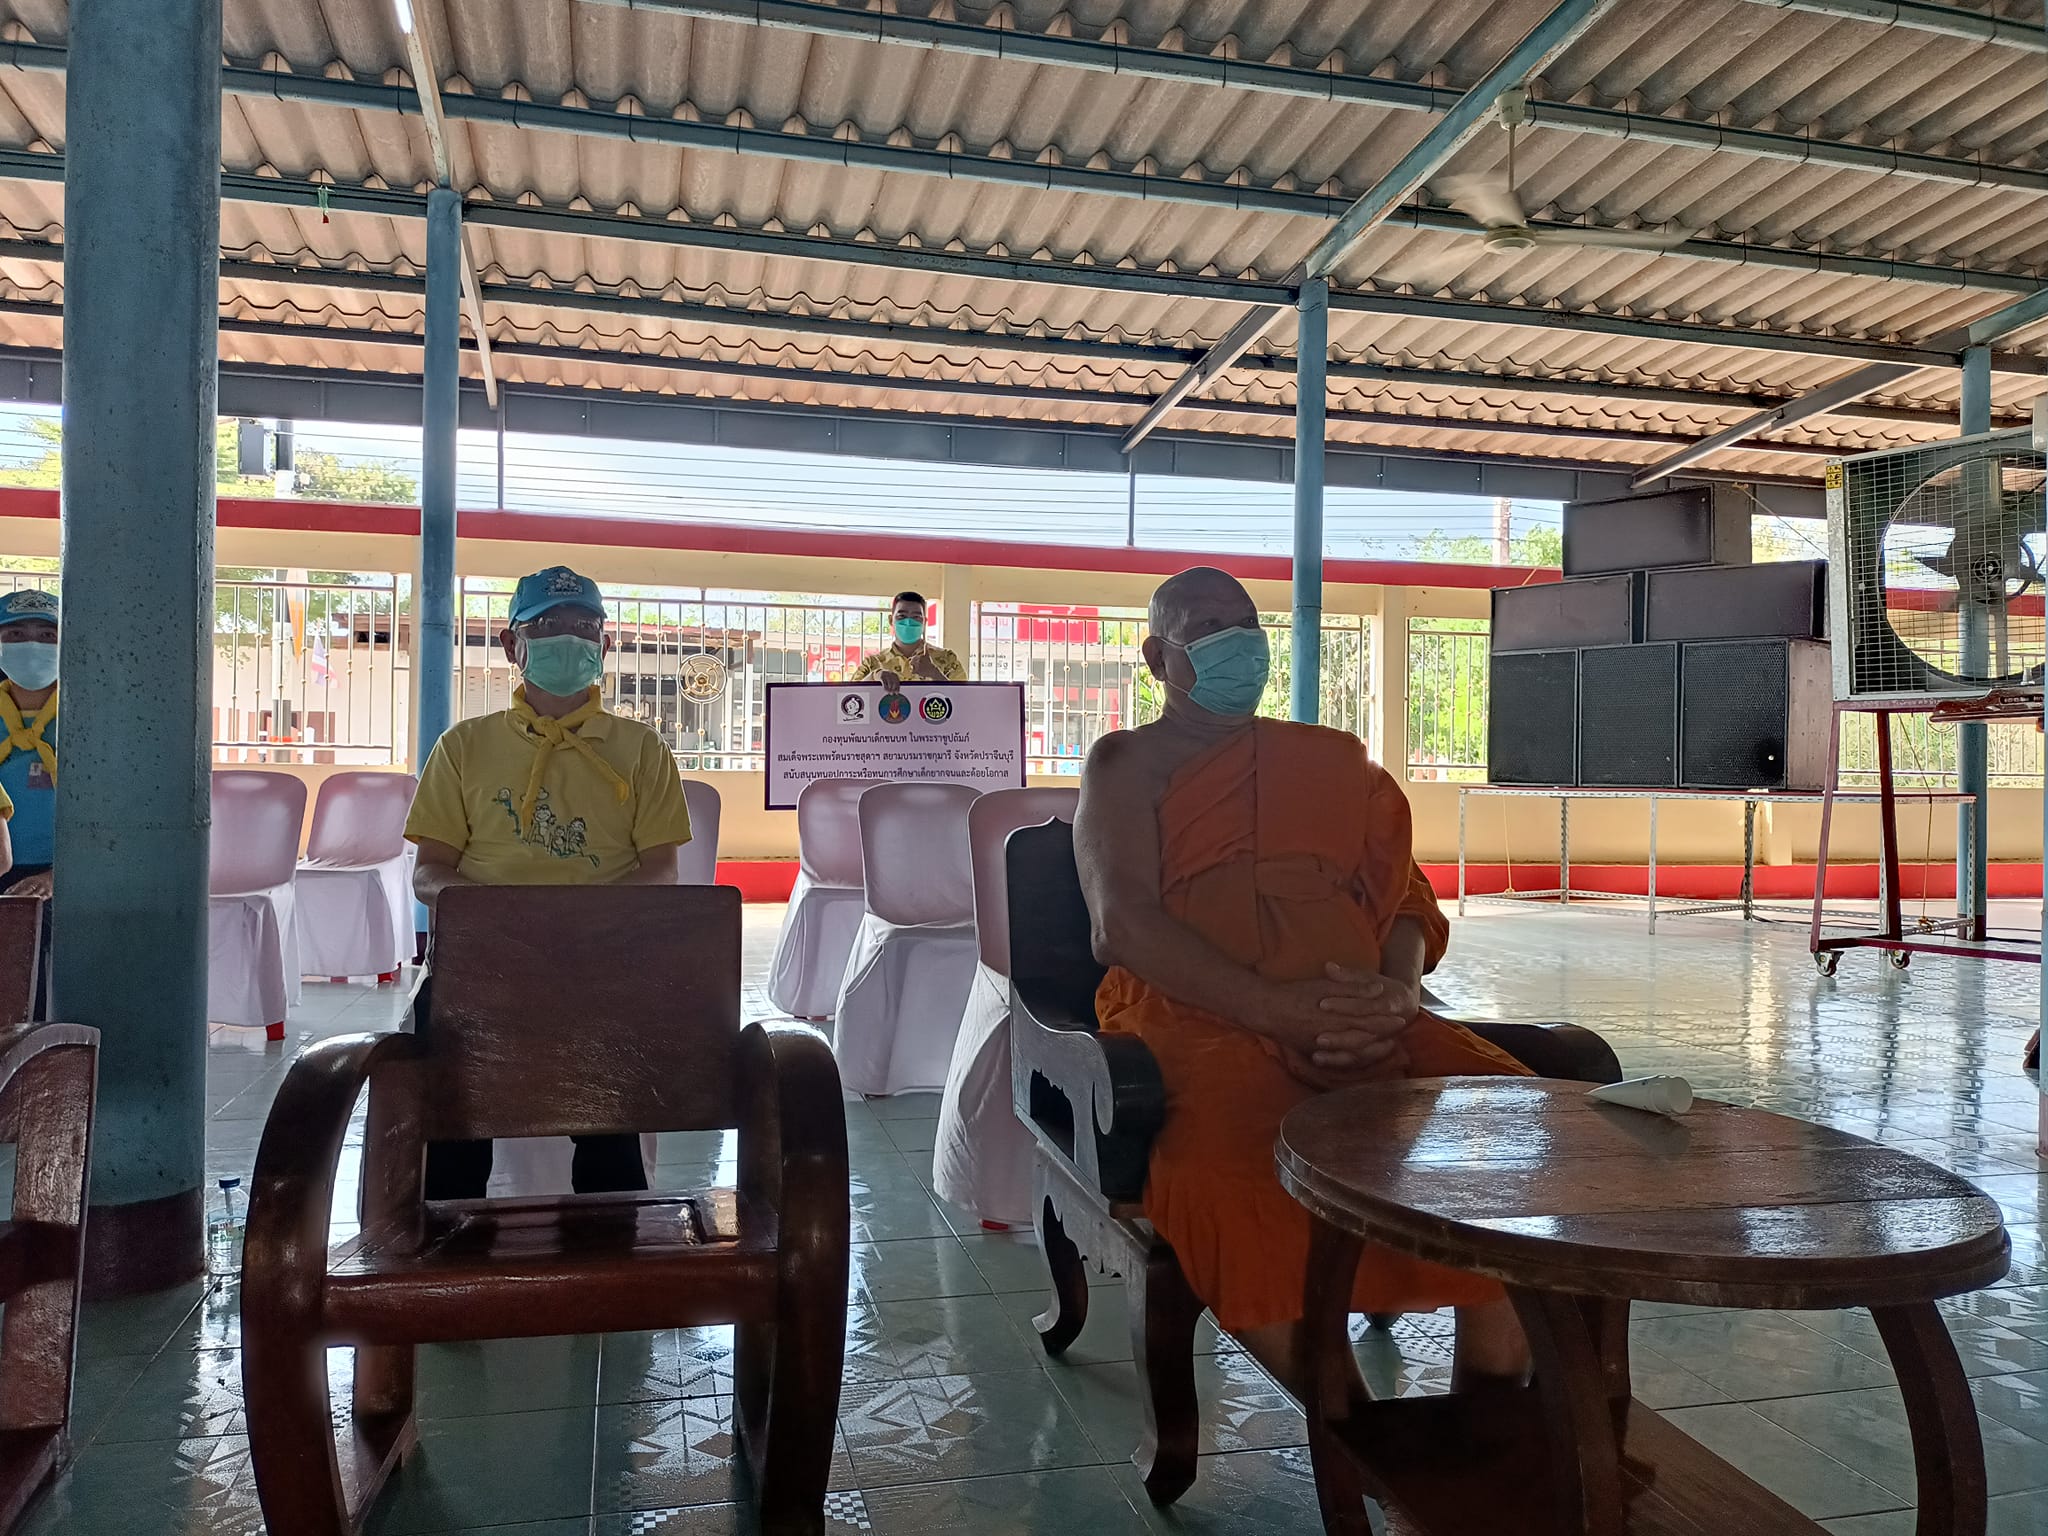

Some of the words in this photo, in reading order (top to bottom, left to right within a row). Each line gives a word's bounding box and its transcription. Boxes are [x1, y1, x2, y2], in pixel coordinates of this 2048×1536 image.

[822, 732, 907, 746] กองทุนพัฒนาเด็กชนบท
[909, 731, 970, 746] ในพระราชูปถัมภ์
[777, 750, 880, 763] สมเด็จพระเทพรัตนราชสุดาฯ
[883, 750, 951, 763] สยามบรมราชกุมารี
[954, 749, 1014, 763] จังหวัดปราจีนบุรี
[783, 766, 1009, 781] สนับสนุนทนอปการะหรือทนการศึกษาเด็กยากจนและด้อยโอกาส
